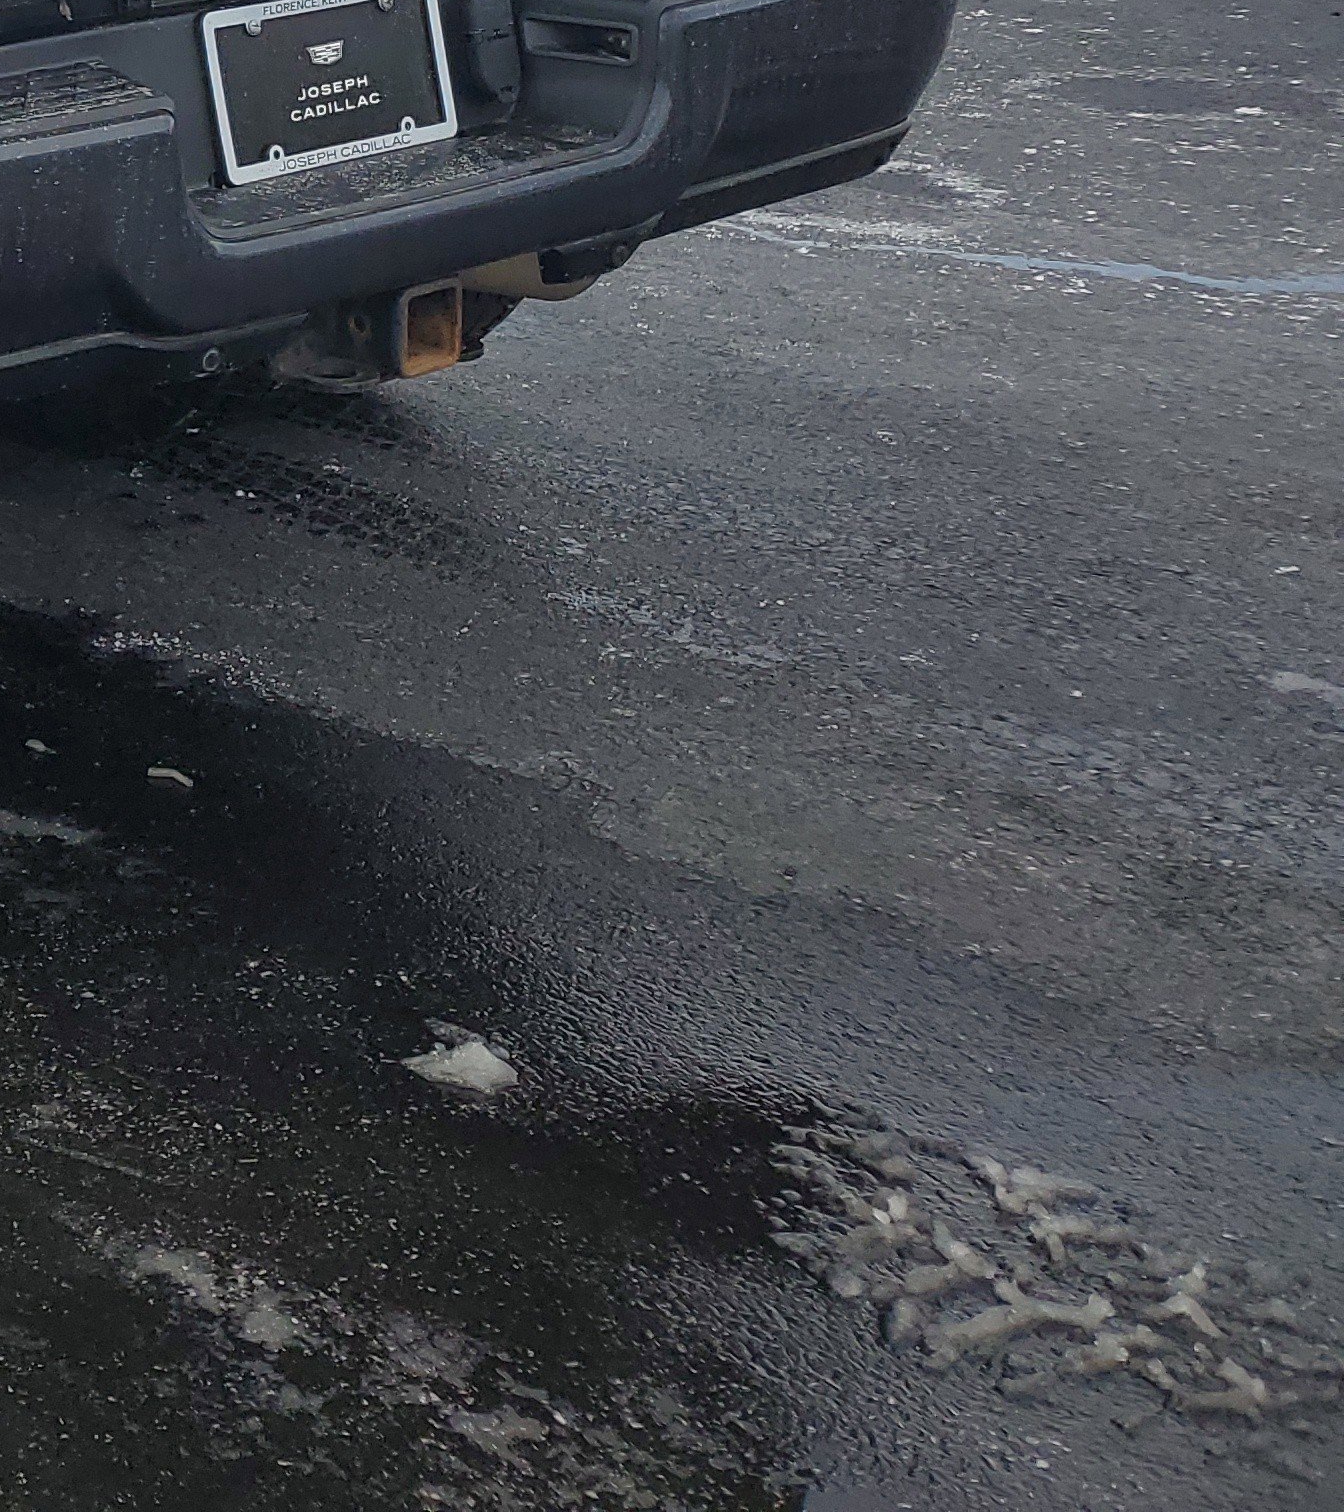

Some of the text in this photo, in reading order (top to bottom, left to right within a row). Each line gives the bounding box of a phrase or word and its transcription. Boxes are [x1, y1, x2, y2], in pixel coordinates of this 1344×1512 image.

[297, 74, 369, 101] JOSEPH
[290, 92, 382, 122] CADILLAC
[279, 133, 412, 172] JOSEPH CADILLAC
